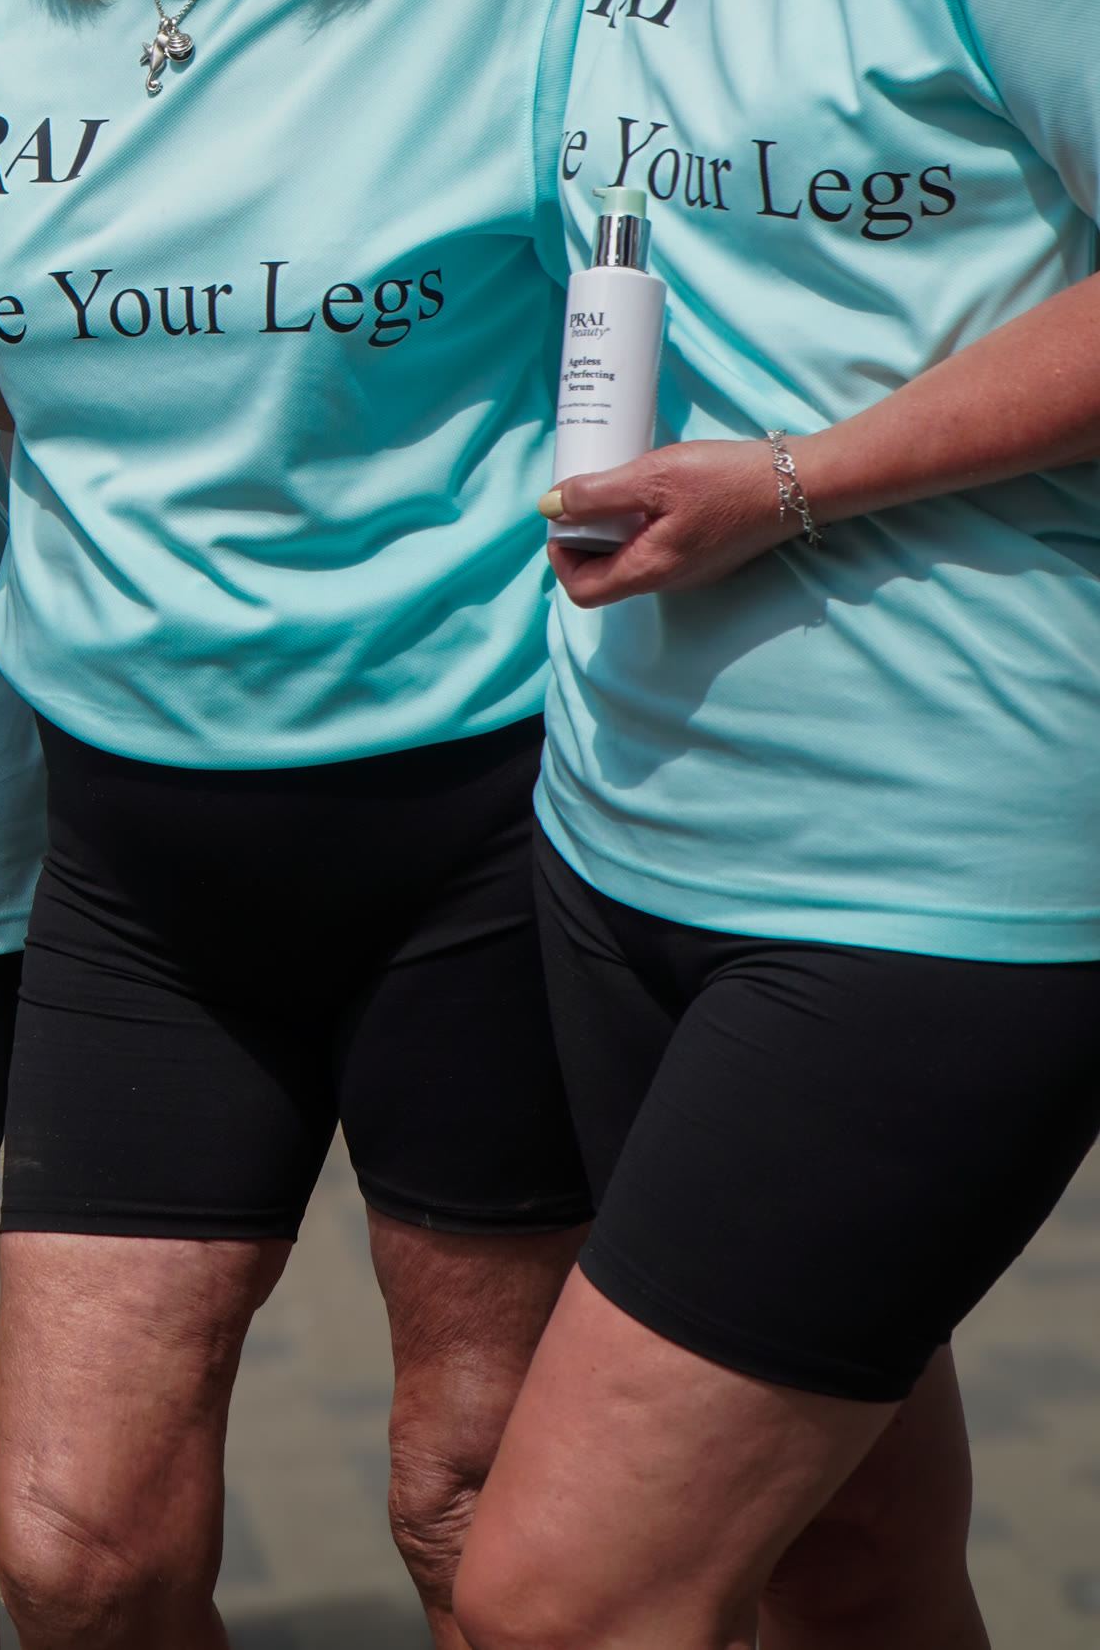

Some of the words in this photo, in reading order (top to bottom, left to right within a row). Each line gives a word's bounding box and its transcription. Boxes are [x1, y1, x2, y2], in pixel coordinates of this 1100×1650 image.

[608, 117, 732, 210] Your
[752, 139, 956, 240] Legs
[48, 268, 232, 339] Your
[259, 260, 445, 348] Legs
[569, 312, 604, 328] PRAI
[568, 356, 601, 368] Ageless
[569, 370, 615, 381] Perfecting
[568, 383, 595, 391] Serum
